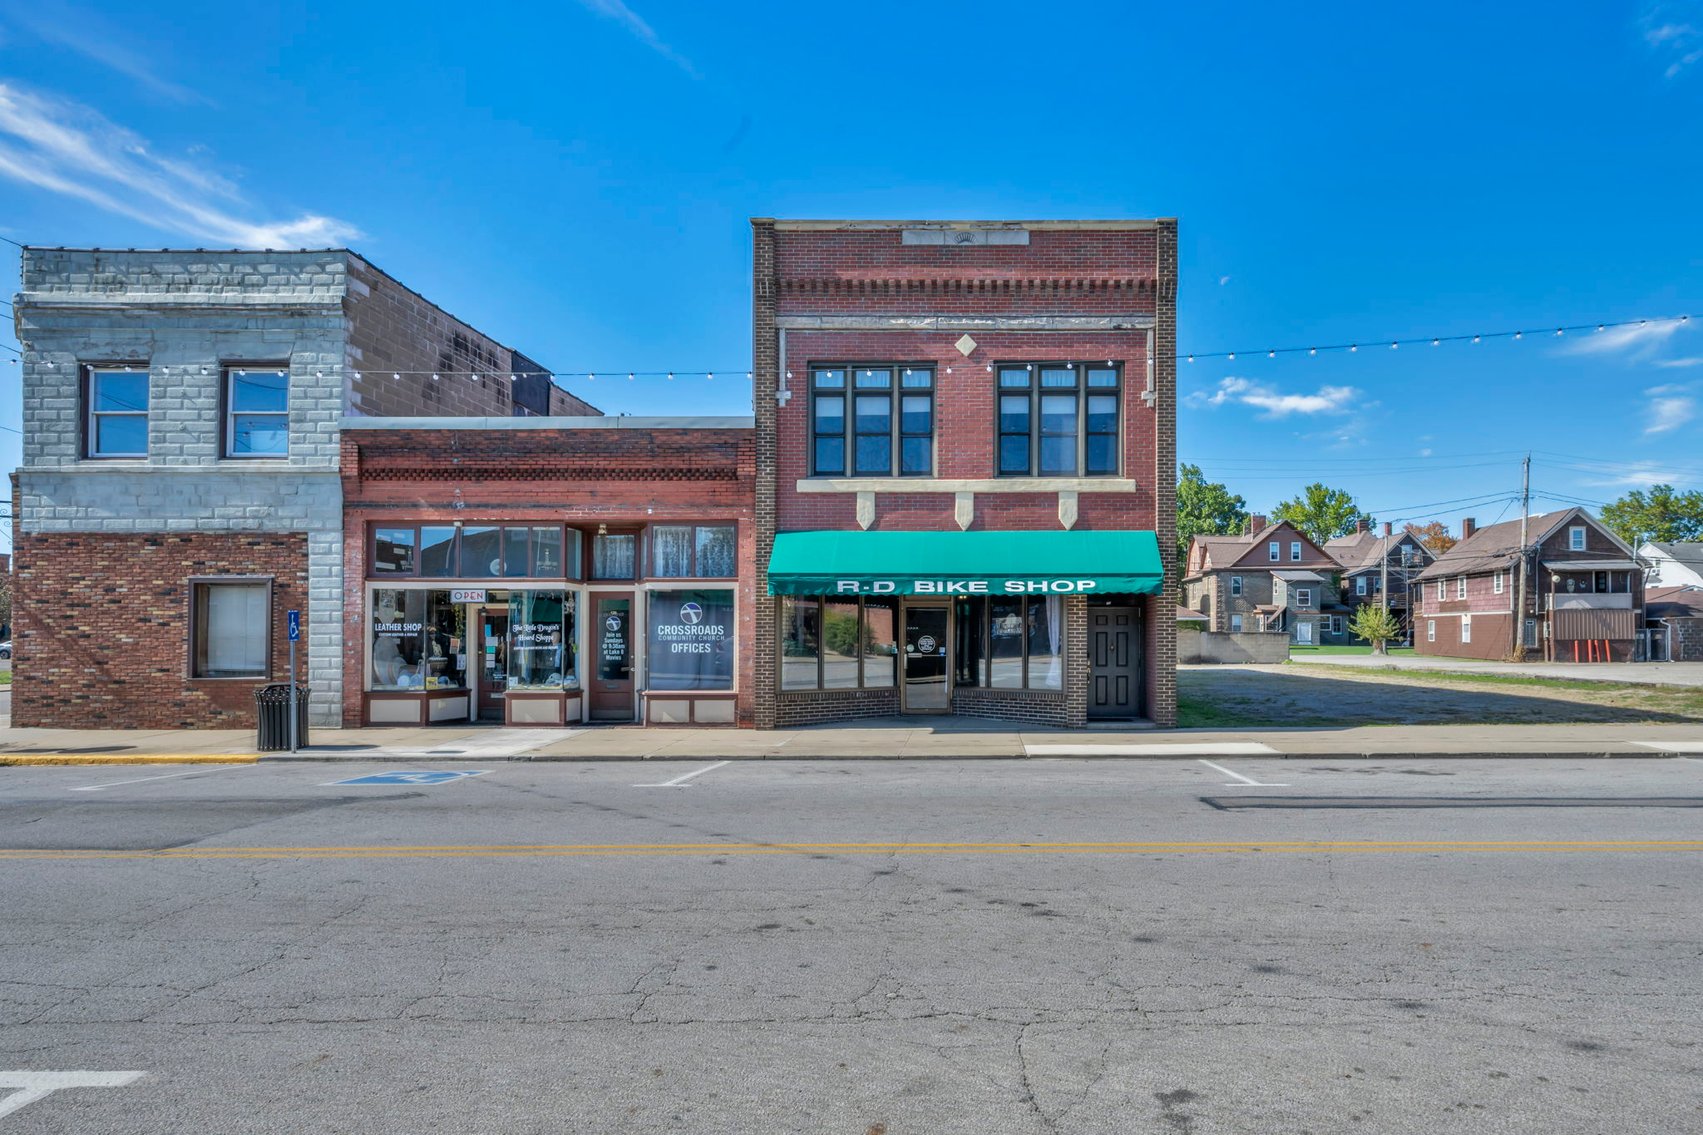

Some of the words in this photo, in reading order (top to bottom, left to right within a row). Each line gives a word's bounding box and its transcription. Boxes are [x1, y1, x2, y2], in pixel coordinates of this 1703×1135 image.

[914, 580, 988, 593] BIKE
[1004, 580, 1096, 593] SHOP
[454, 591, 484, 600] OPEN
[374, 623, 402, 631] LEATHER
[403, 623, 422, 631] SHOP
[512, 623, 523, 632] The
[657, 625, 725, 635] CROSSROADS
[671, 643, 711, 653] OFFICES
